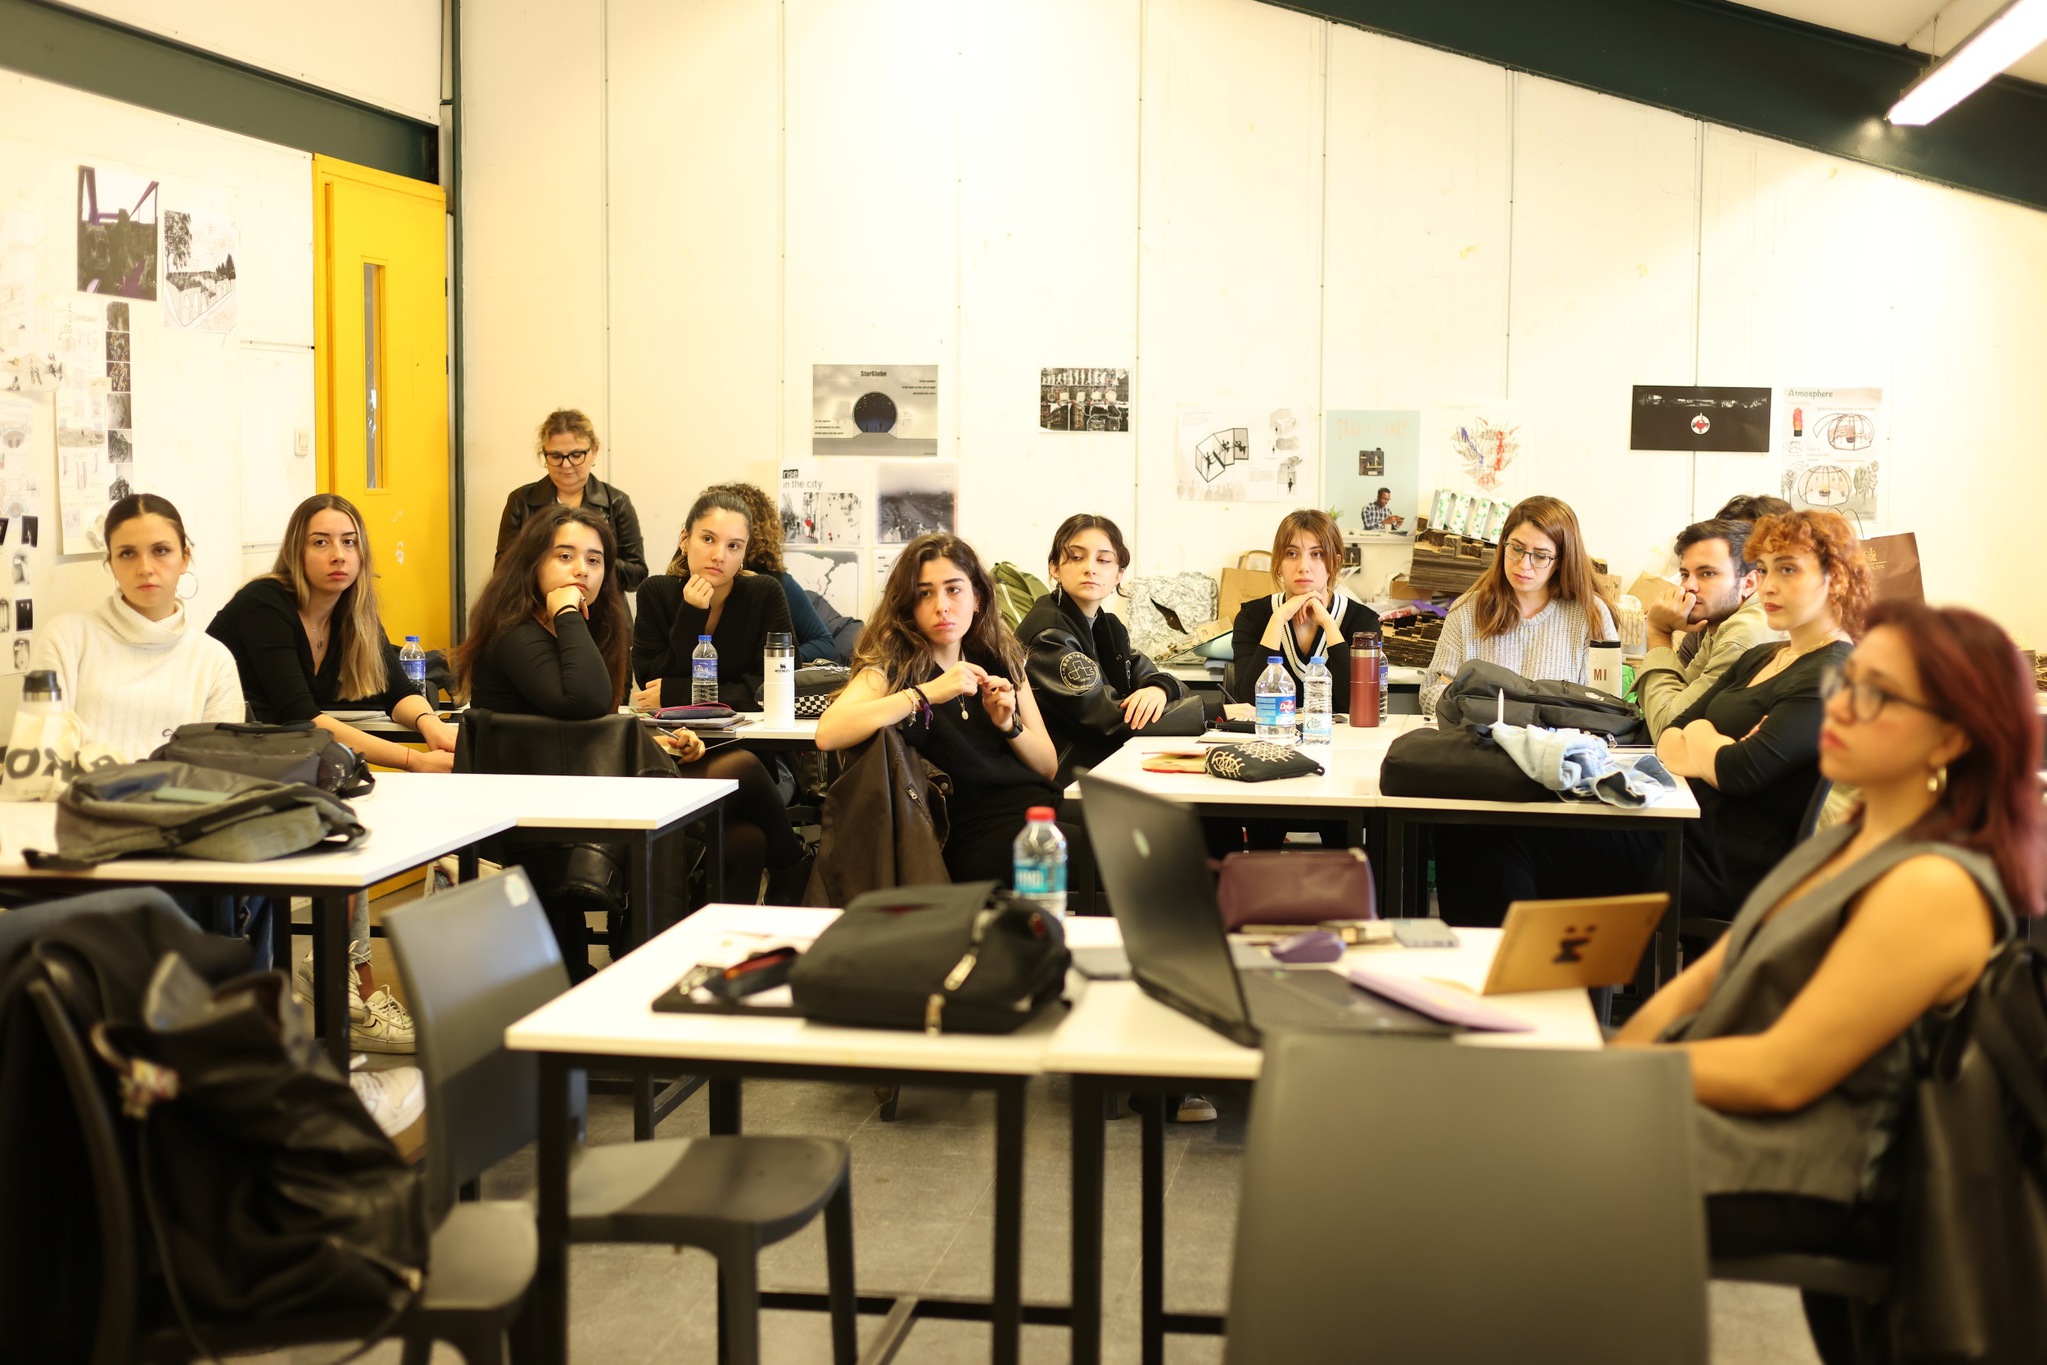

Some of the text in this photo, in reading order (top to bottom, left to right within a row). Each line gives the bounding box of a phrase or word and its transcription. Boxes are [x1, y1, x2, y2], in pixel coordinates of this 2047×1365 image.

[1788, 388, 1833, 399] Atmosphere
[783, 470, 799, 479] rise
[783, 480, 823, 491] in the city
[1593, 668, 1607, 681] MI
